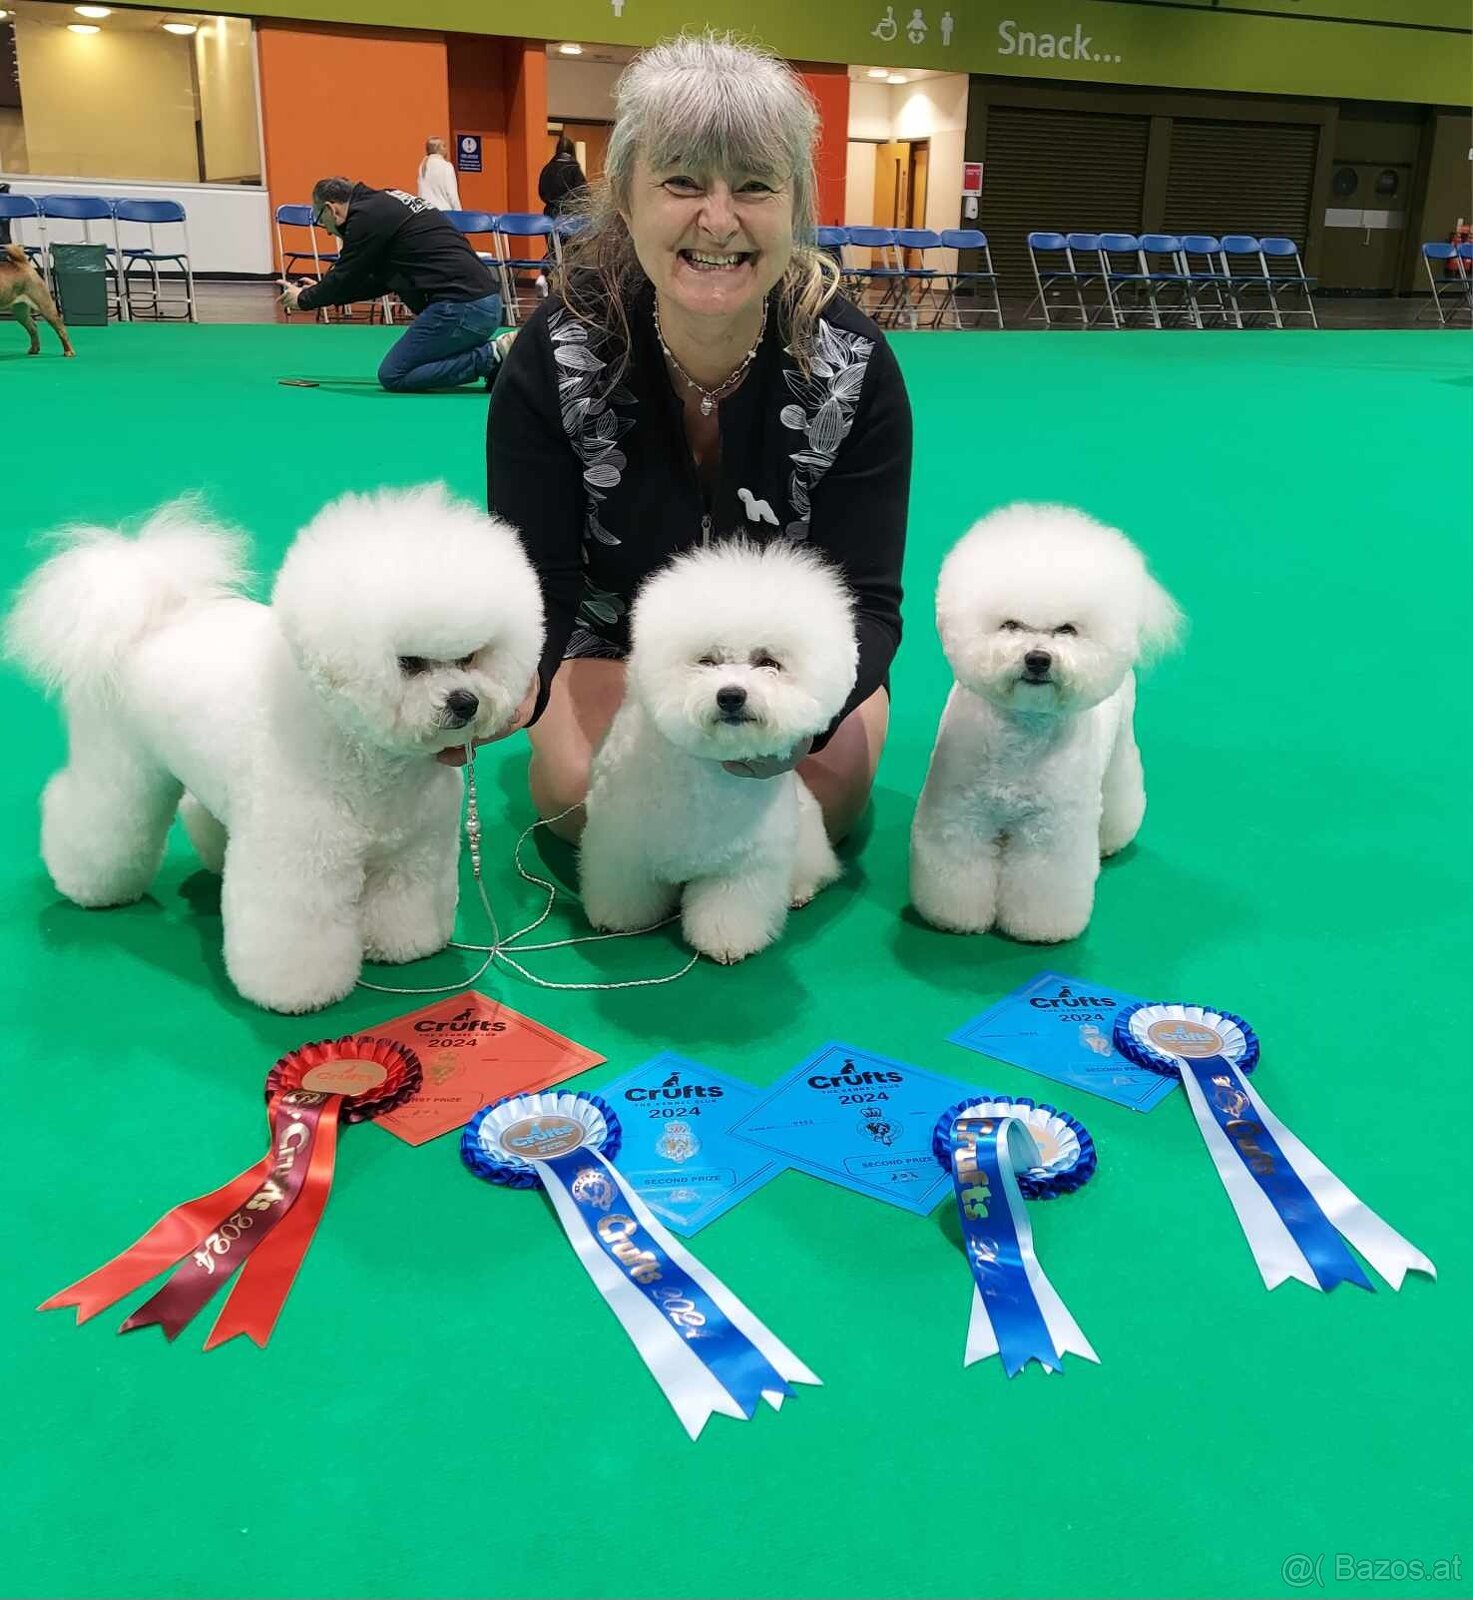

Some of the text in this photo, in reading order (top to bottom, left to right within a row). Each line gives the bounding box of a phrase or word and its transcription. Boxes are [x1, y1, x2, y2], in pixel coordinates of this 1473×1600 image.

[1030, 997, 1117, 1008] Crufts
[1059, 1013, 1104, 1022] 2024
[414, 1019, 507, 1032] Crufts
[427, 1039, 477, 1048] 2024
[807, 1071, 903, 1090] Crufts
[624, 1085, 724, 1102] Crufts
[838, 1091, 889, 1105] 2024
[648, 1106, 701, 1119] 2024
[861, 1156, 934, 1168] SECOND PRIZE
[644, 1174, 722, 1186] SECOND PRIZE
[193, 1212, 255, 1275] 2024
[597, 1213, 664, 1285] Crufts
